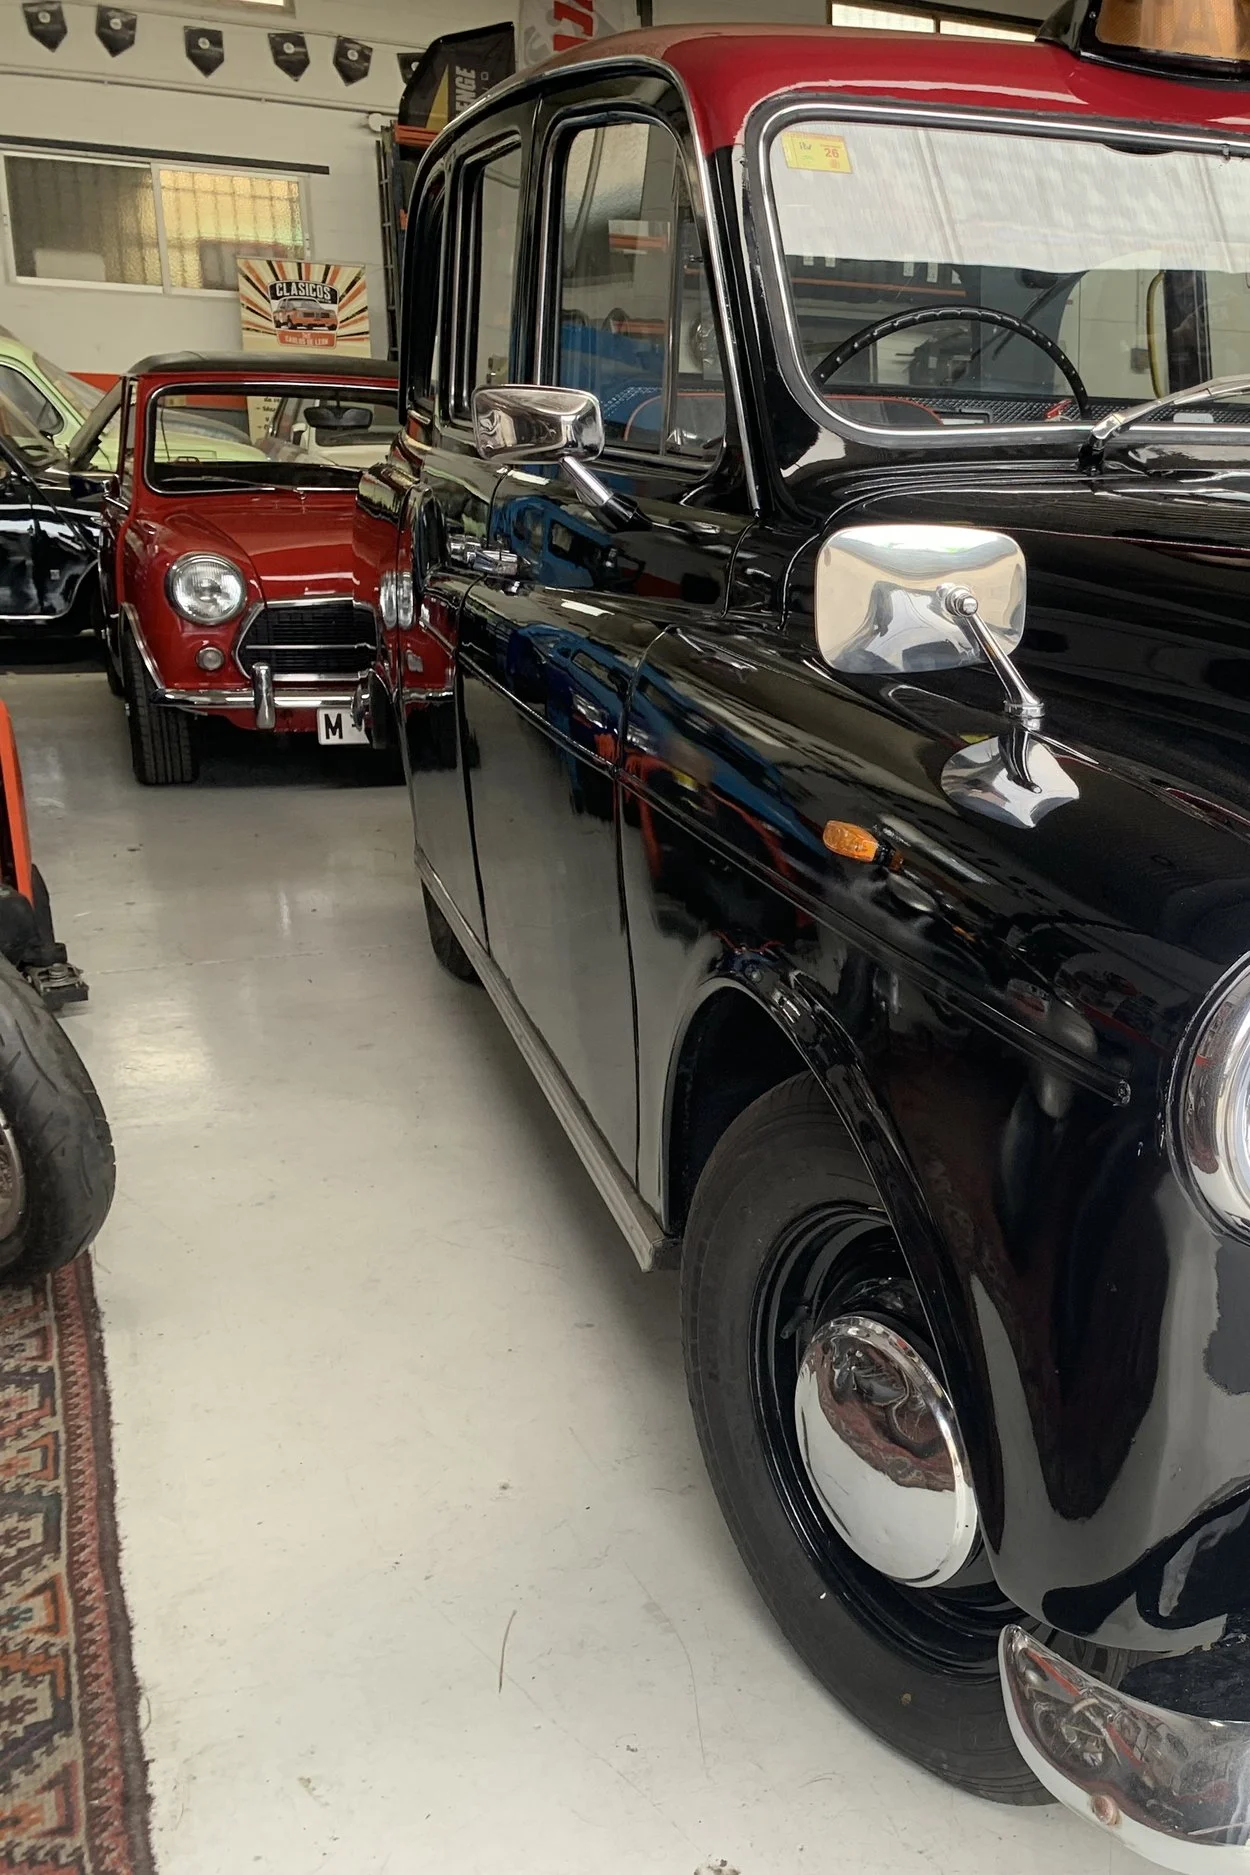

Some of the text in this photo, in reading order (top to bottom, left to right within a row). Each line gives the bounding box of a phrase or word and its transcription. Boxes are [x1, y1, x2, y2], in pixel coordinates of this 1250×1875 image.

[455, 66, 477, 117] ENGE
[824, 147, 840, 159] 26
[275, 282, 332, 300] CLASICOS
[324, 713, 344, 740] M
